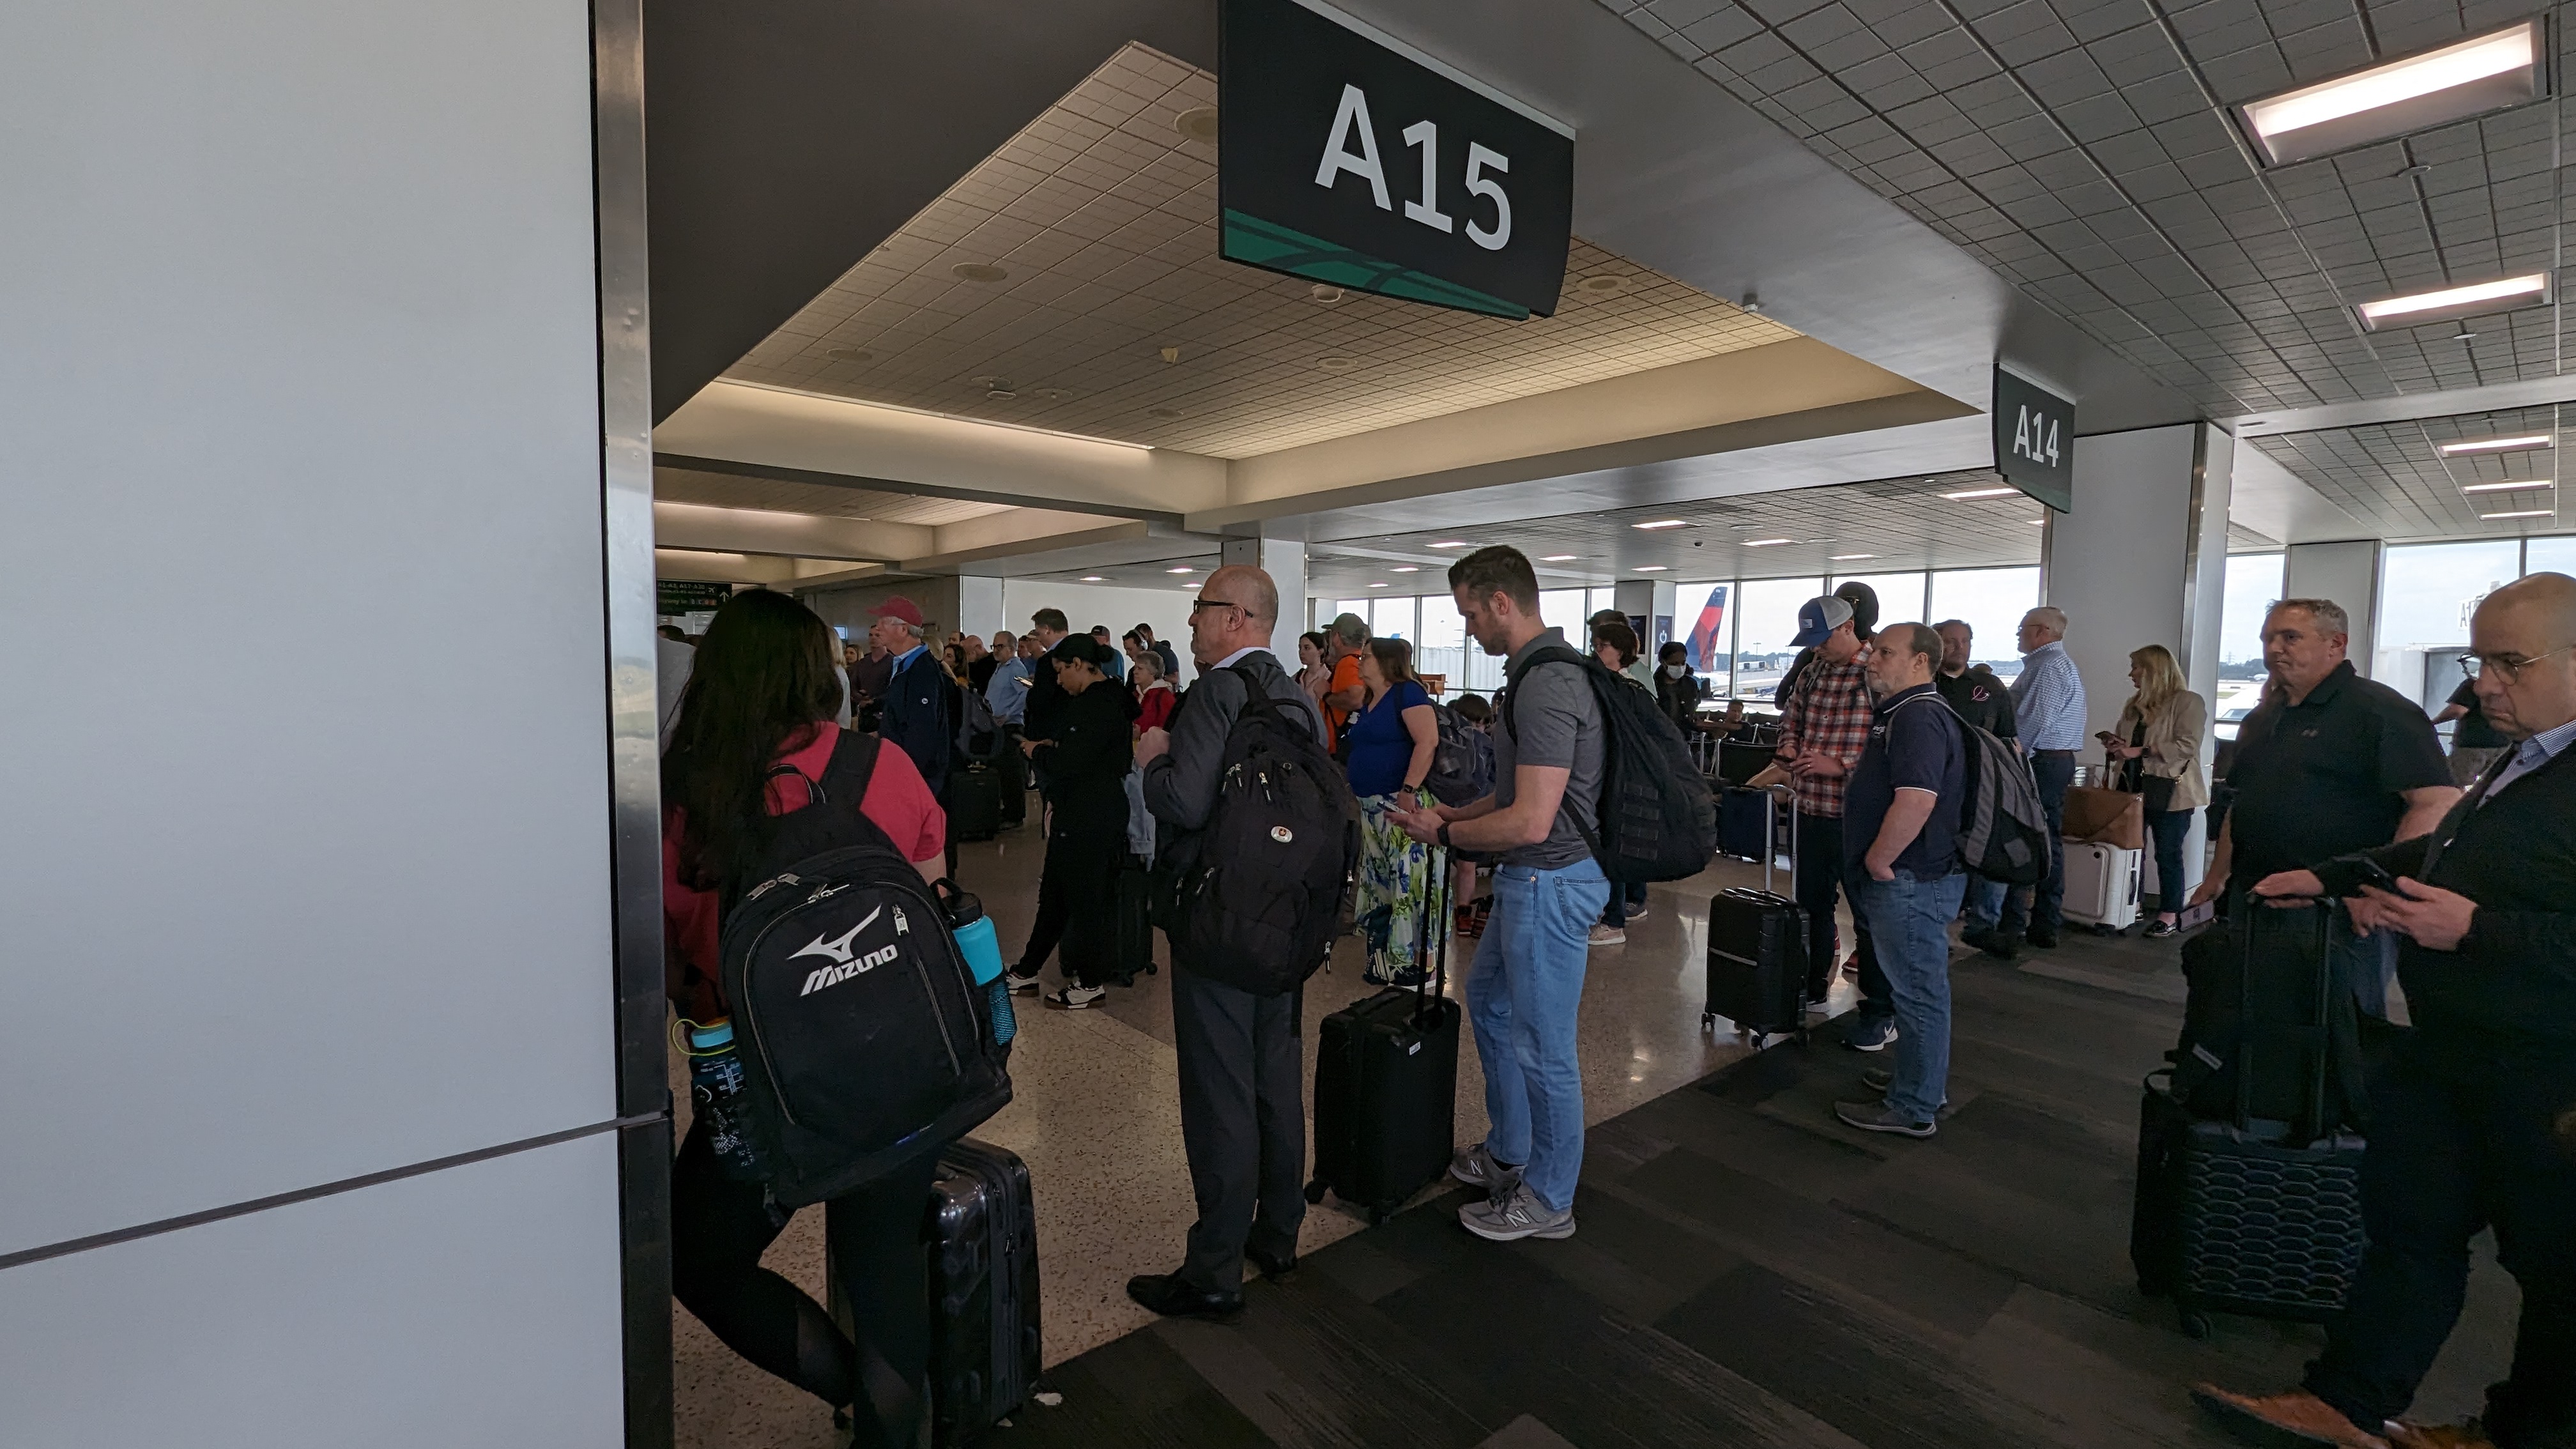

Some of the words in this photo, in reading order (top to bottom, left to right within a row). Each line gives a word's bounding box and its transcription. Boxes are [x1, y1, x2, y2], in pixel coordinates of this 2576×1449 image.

[1314, 83, 1512, 250] A15
[2013, 404, 2058, 468] A14
[1469, 1159, 1483, 1176] N
[1505, 1209, 1531, 1228] N
